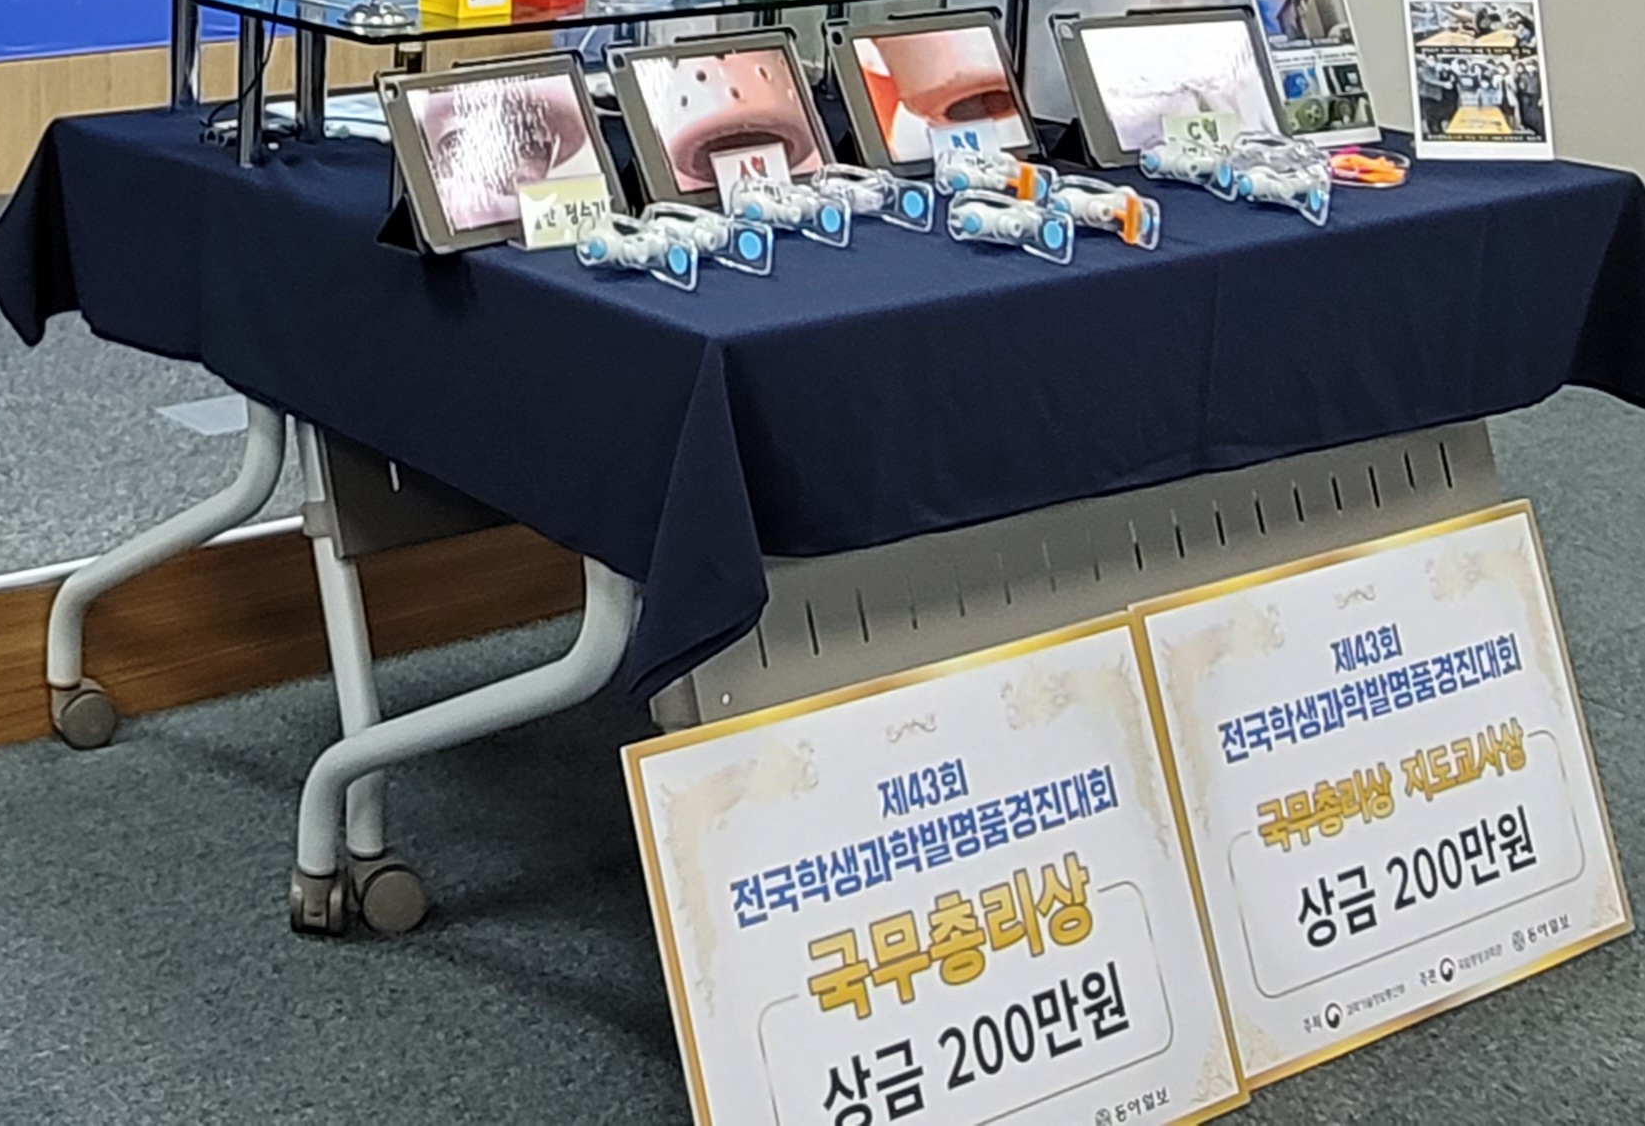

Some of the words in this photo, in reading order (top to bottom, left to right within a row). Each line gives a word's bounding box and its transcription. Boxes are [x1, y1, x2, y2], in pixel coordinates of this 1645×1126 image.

[1218, 632, 1524, 765] 전국학생과학발명품경진대회
[1330, 623, 1403, 674] 제43회
[730, 765, 1120, 929] 전국학생과학발명품경진대회
[877, 758, 970, 818] 제43회
[1256, 762, 1395, 853] 국무총리상
[1400, 716, 1527, 802] 지도교사상
[808, 851, 1094, 1020] 국무총리상
[1297, 865, 1378, 949] 상금
[1386, 804, 1538, 911] 200만원
[1527, 914, 1571, 944] 동아일보
[823, 1038, 925, 1126] 상금
[938, 960, 1130, 1091] 200만원
[1114, 1087, 1171, 1124] 동아일보
